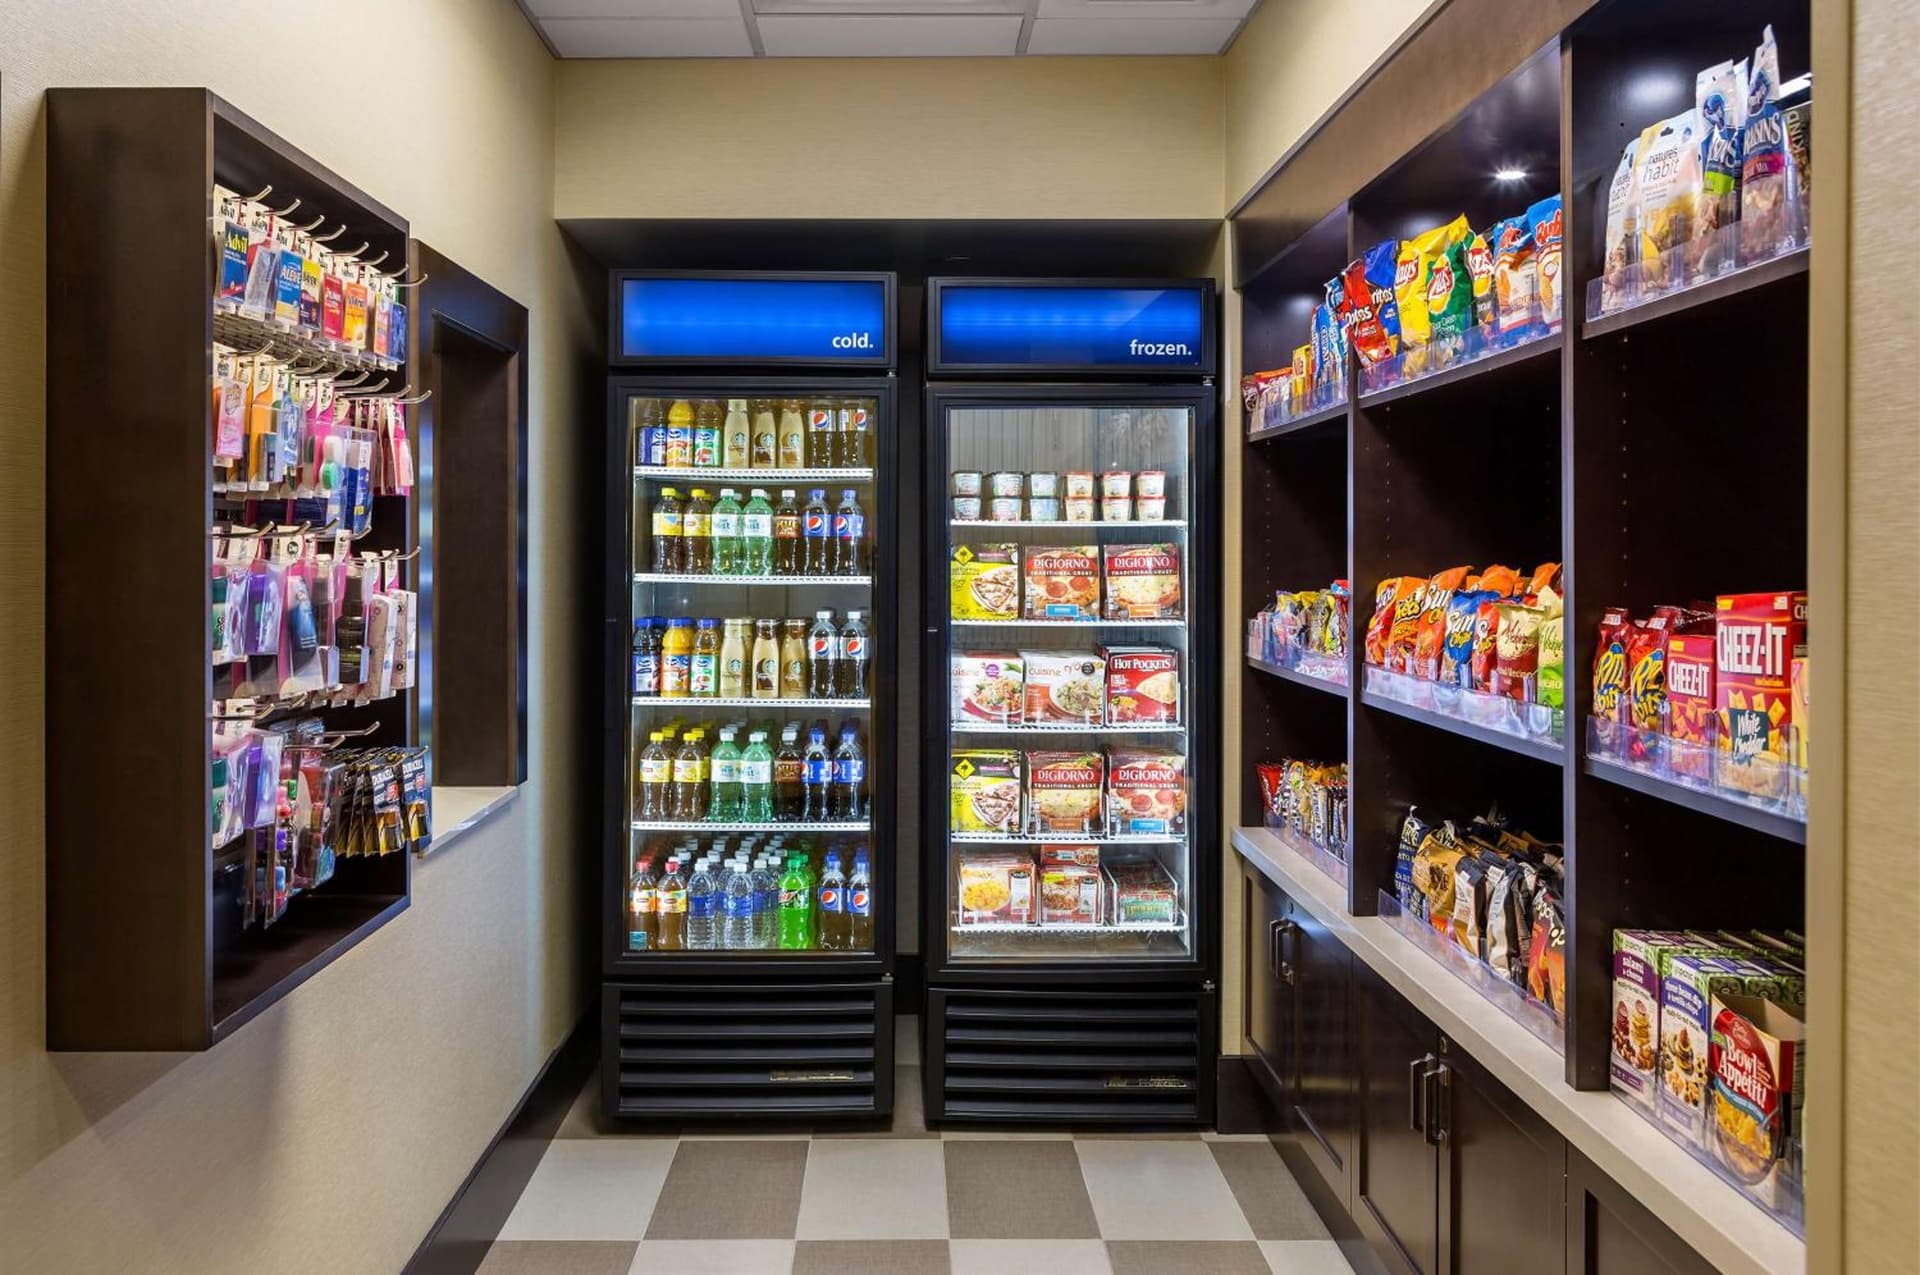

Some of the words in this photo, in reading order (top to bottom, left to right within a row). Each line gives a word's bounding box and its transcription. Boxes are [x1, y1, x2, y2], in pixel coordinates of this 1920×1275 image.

[832, 332, 874, 350] cold.
[1129, 338, 1192, 357] frozen.
[1717, 622, 1786, 677] CHEEZ-IT
[1114, 658, 1131, 669] HOT
[1132, 658, 1172, 670] POCKETS
[1669, 660, 1710, 698] CHEEZ-IT
[1726, 1035, 1757, 1079] Bowl
